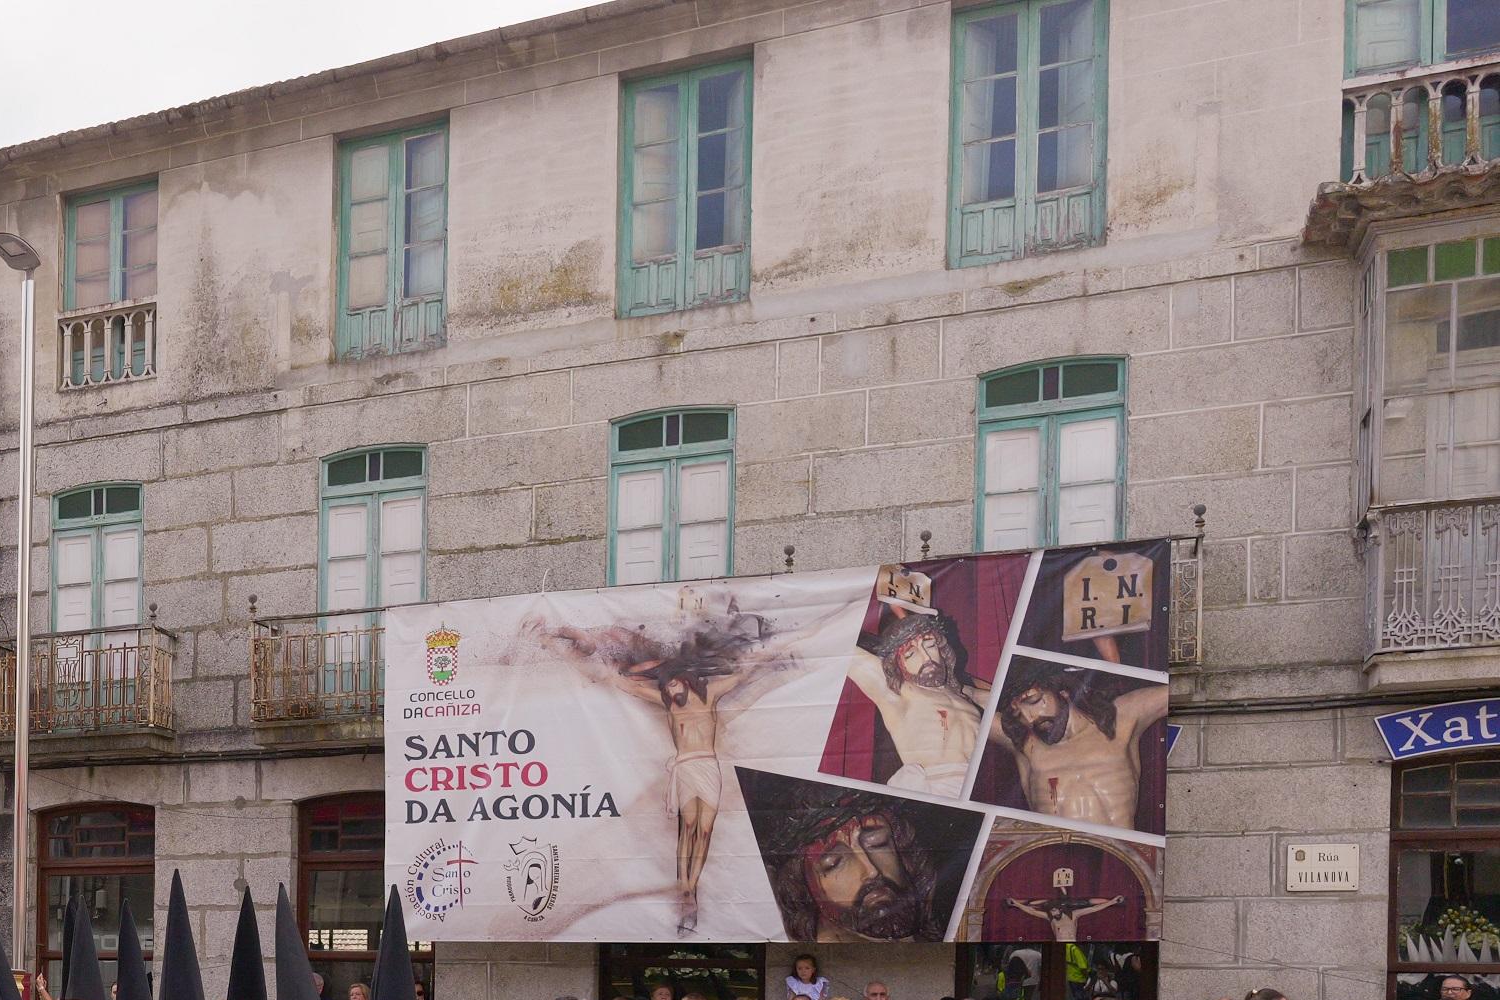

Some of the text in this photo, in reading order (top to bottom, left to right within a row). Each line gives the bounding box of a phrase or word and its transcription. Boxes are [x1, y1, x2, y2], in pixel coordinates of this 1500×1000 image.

[1082, 574, 1143, 601] I. N.
[1122, 604, 1132, 626] I
[409, 689, 476, 703] CONCELLO
[404, 729, 536, 762] SANTO
[404, 761, 548, 793] CRISTO
[405, 785, 621, 824] DA AGONÍA
[552, 844, 560, 862] SANTA
[1318, 852, 1339, 862] Rúa
[405, 838, 446, 922] Asociación Cultural
[1298, 871, 1350, 883] VILANOVA
